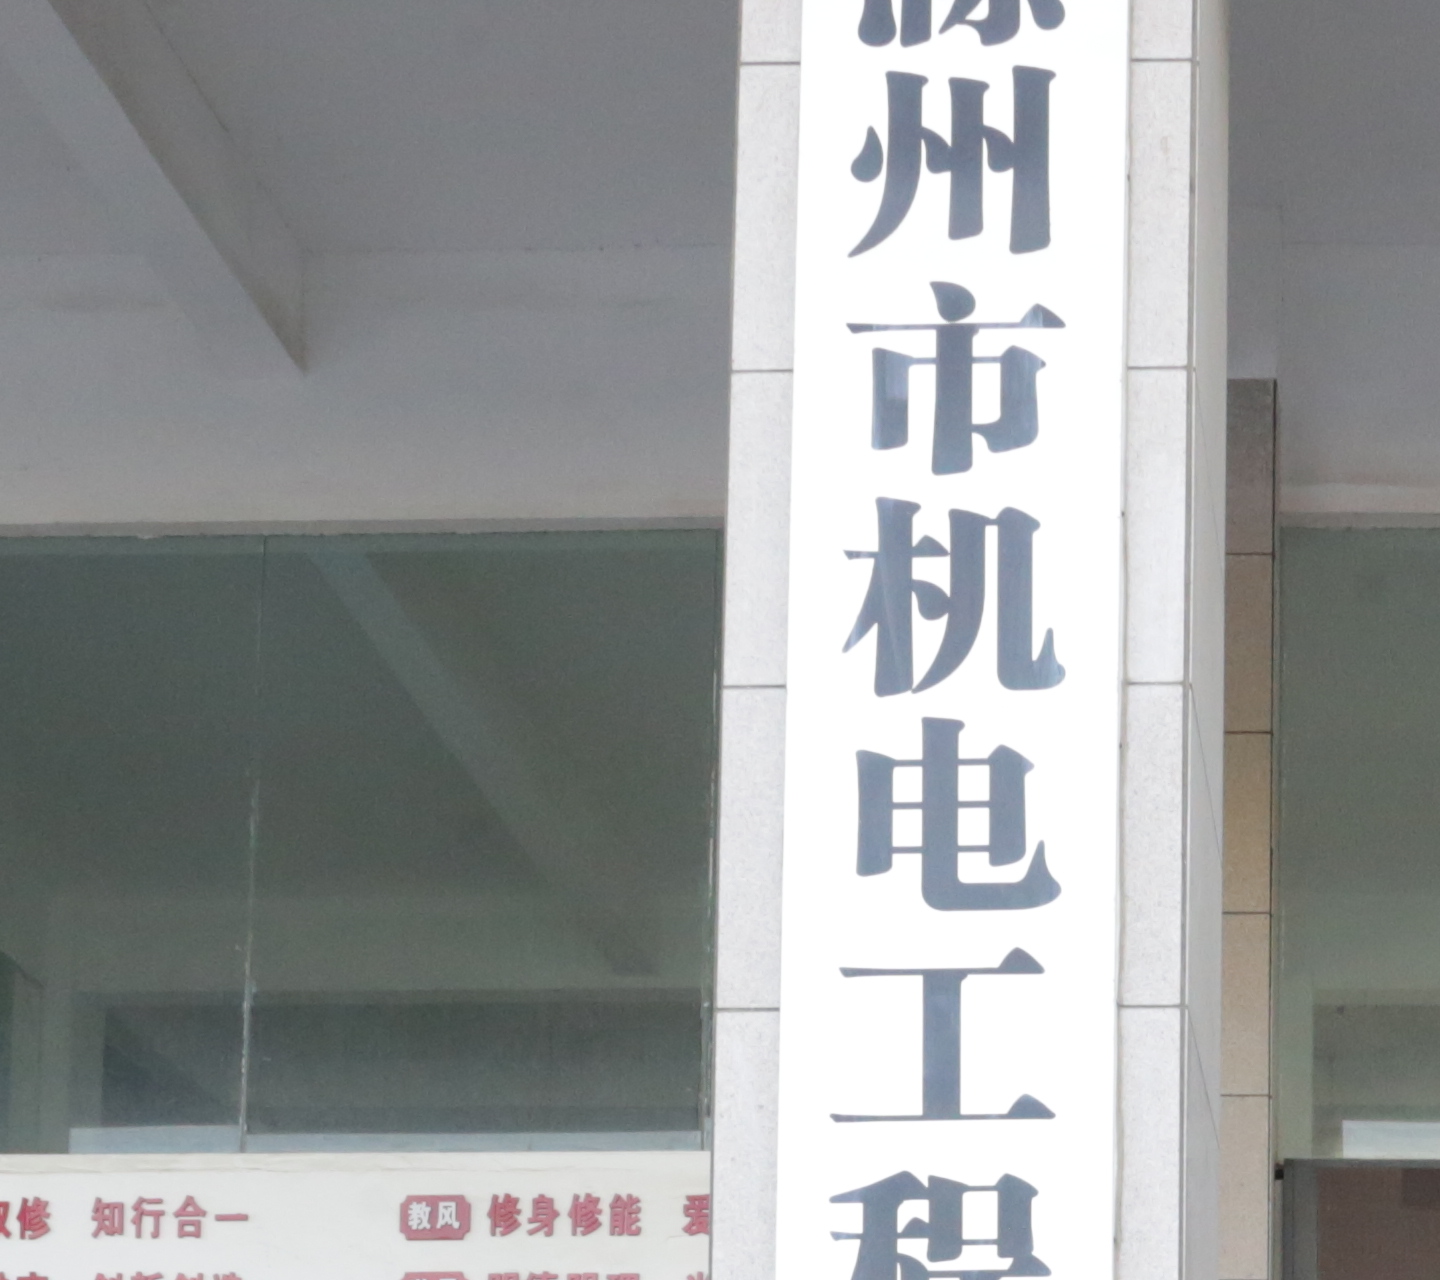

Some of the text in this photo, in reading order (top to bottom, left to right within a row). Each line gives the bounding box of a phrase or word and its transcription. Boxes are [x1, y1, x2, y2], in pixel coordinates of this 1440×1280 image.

[91, 1196, 249, 1239] 知行合一
[407, 1200, 461, 1231] 教风
[486, 1193, 642, 1237] 修身修能
